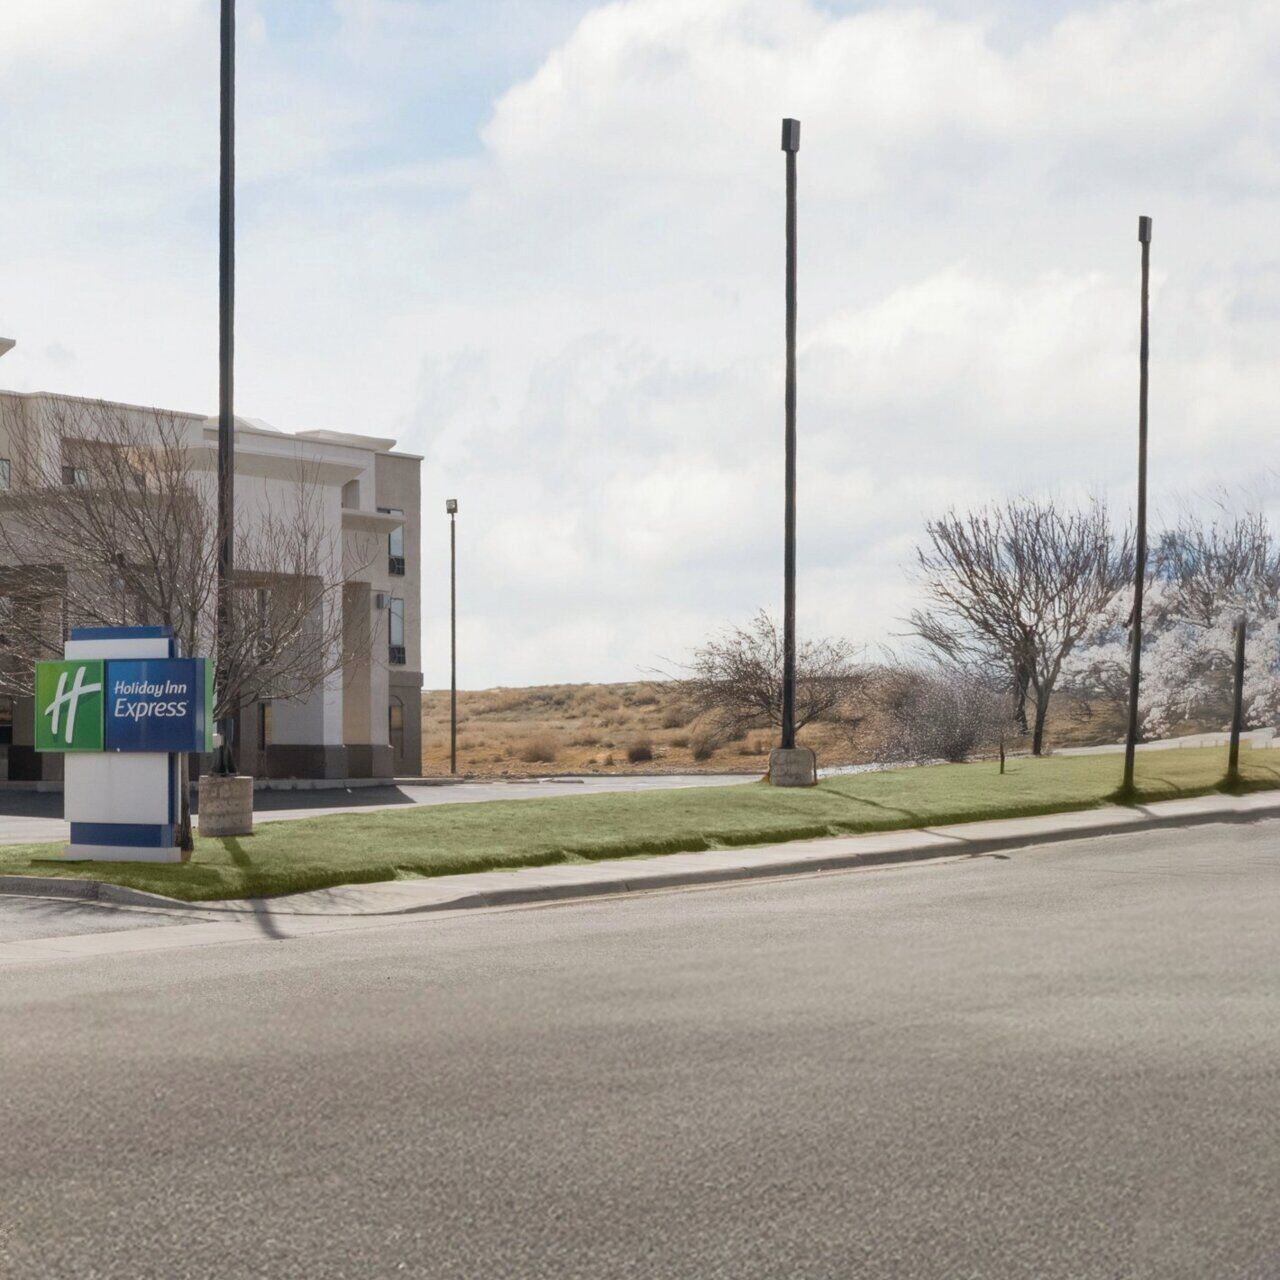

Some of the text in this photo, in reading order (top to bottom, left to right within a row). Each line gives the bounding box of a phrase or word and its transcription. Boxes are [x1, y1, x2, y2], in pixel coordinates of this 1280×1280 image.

[114, 680, 187, 698] Holiday Inn
[114, 698, 188, 722] Express
